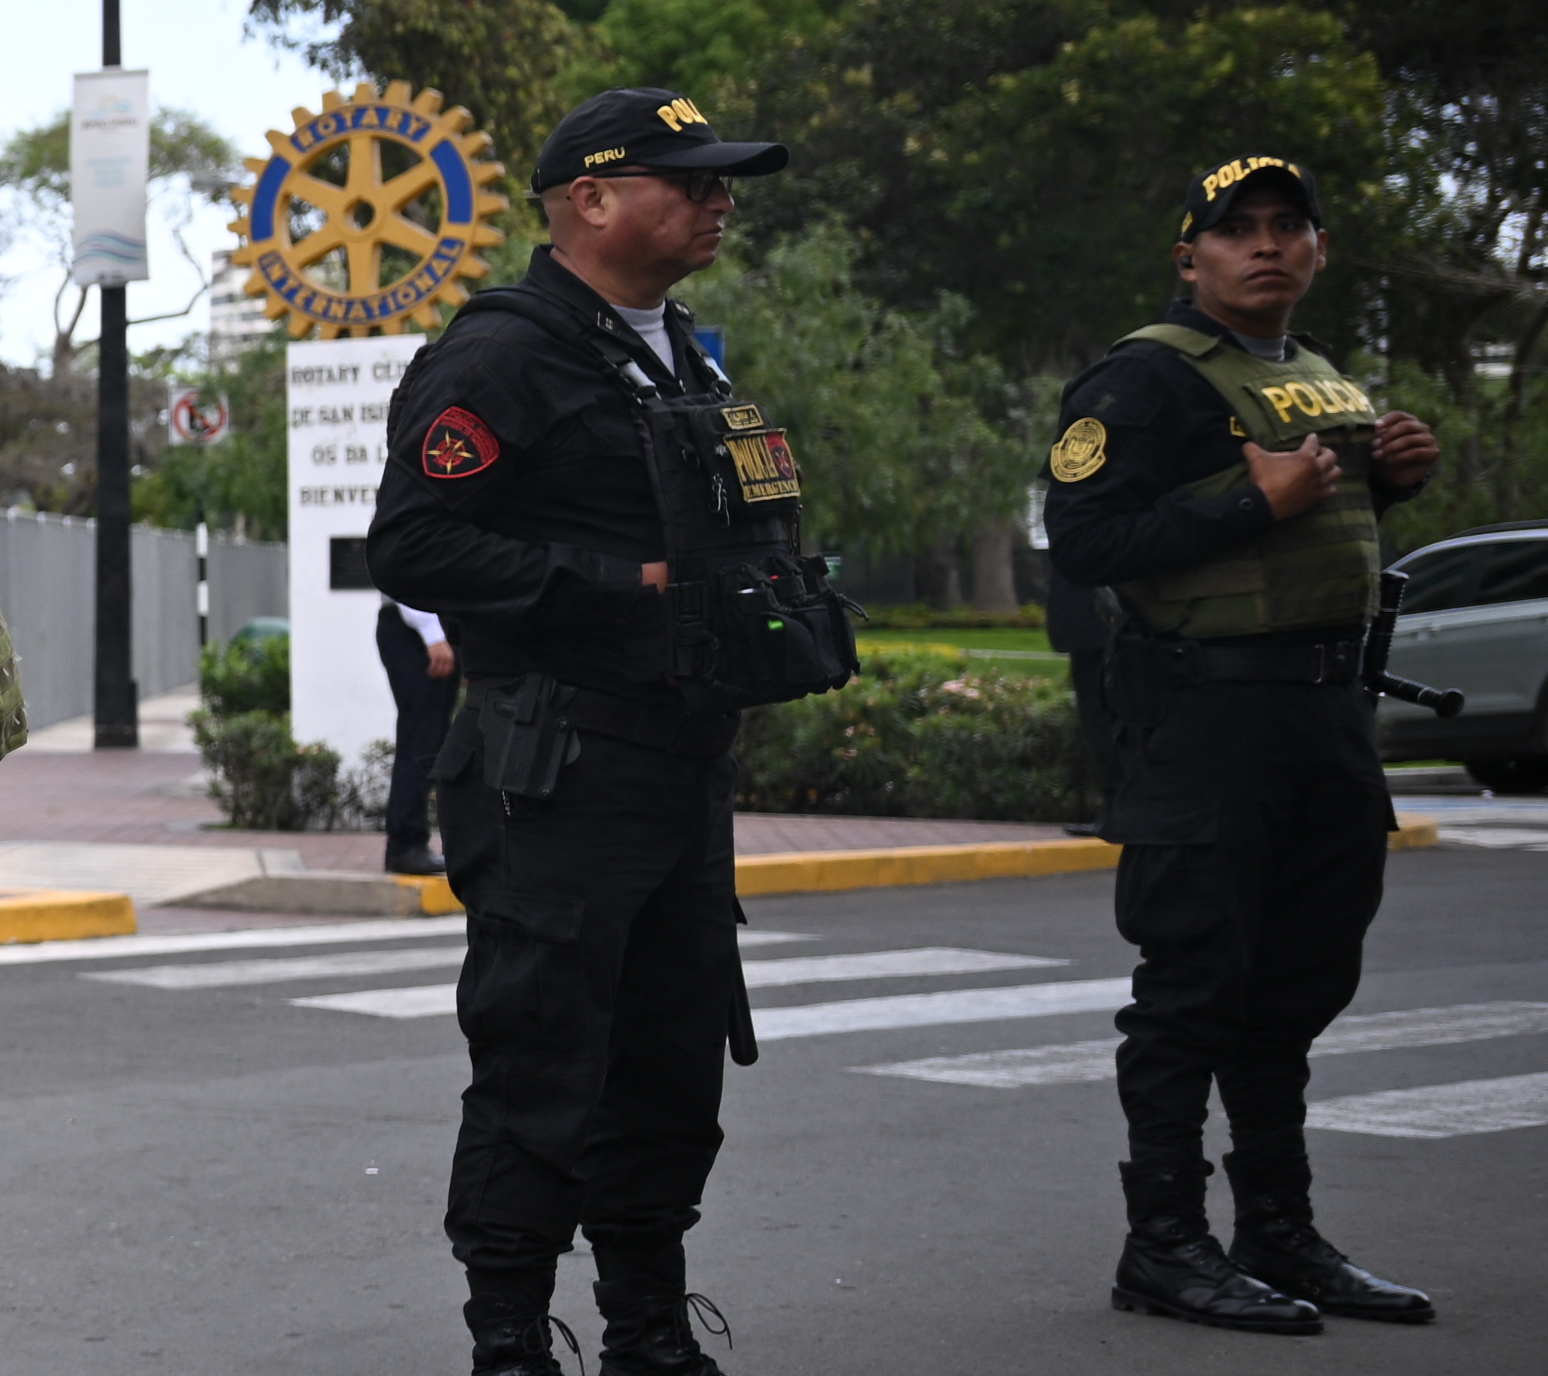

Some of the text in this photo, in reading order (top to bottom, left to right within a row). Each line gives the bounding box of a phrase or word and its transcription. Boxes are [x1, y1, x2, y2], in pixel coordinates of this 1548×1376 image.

[296, 108, 429, 147] ROTARY
[260, 239, 464, 321] INTERNATIONAL
[291, 361, 408, 385] ROTARY CLU
[318, 404, 354, 425] SAN
[1261, 379, 1376, 423] POLICIA
